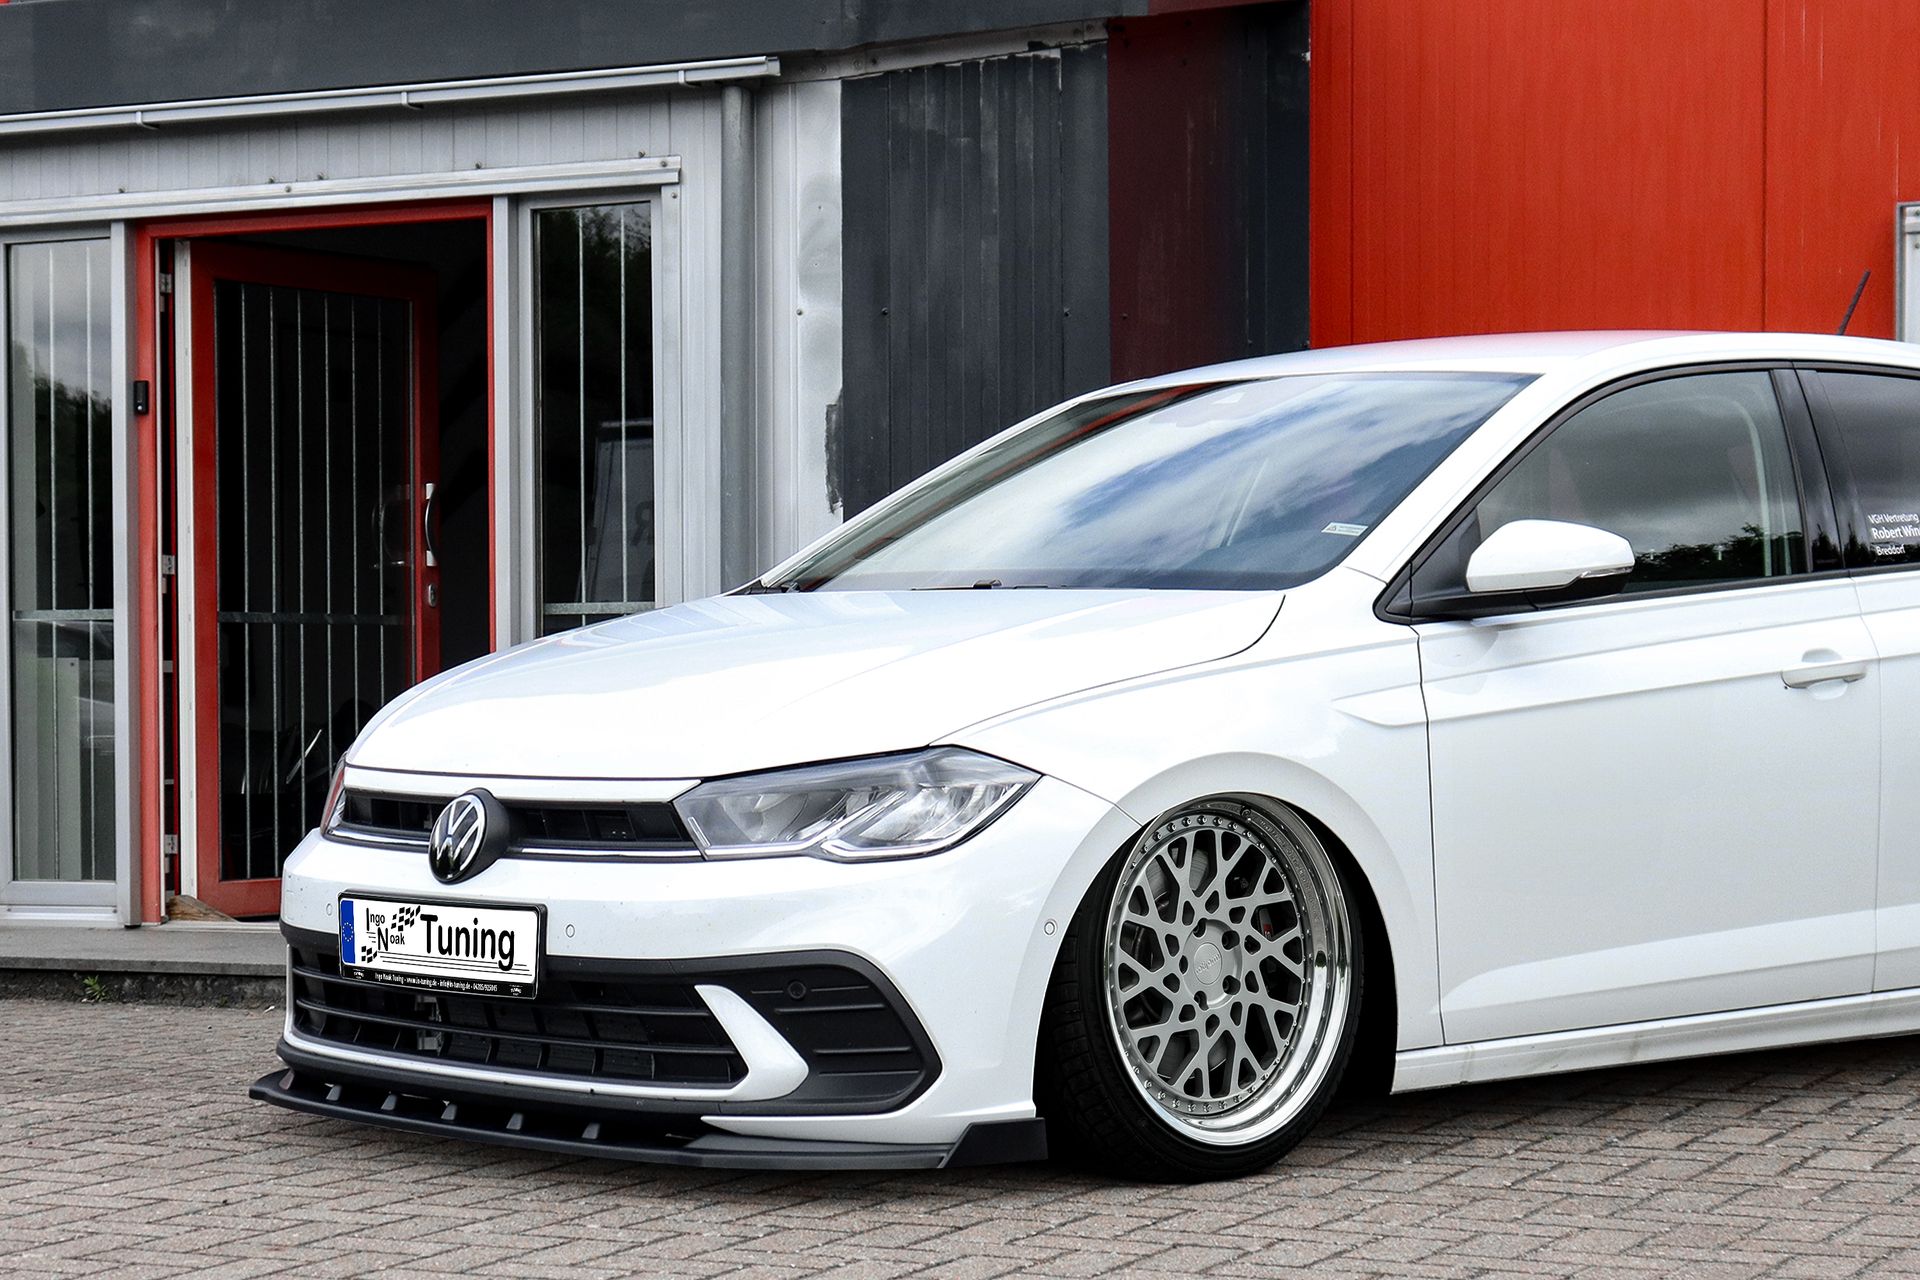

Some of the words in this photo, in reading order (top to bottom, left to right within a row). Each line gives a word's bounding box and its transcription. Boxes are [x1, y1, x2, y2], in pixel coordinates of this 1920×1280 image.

[1868, 514, 1884, 524] VGH
[1884, 513, 1919, 523] Vertretung
[1872, 527, 1903, 539] Robert
[1876, 544, 1906, 556] Breddorf
[366, 908, 386, 927] Ingo
[377, 927, 405, 951] Noak
[420, 914, 515, 971] Tuning
